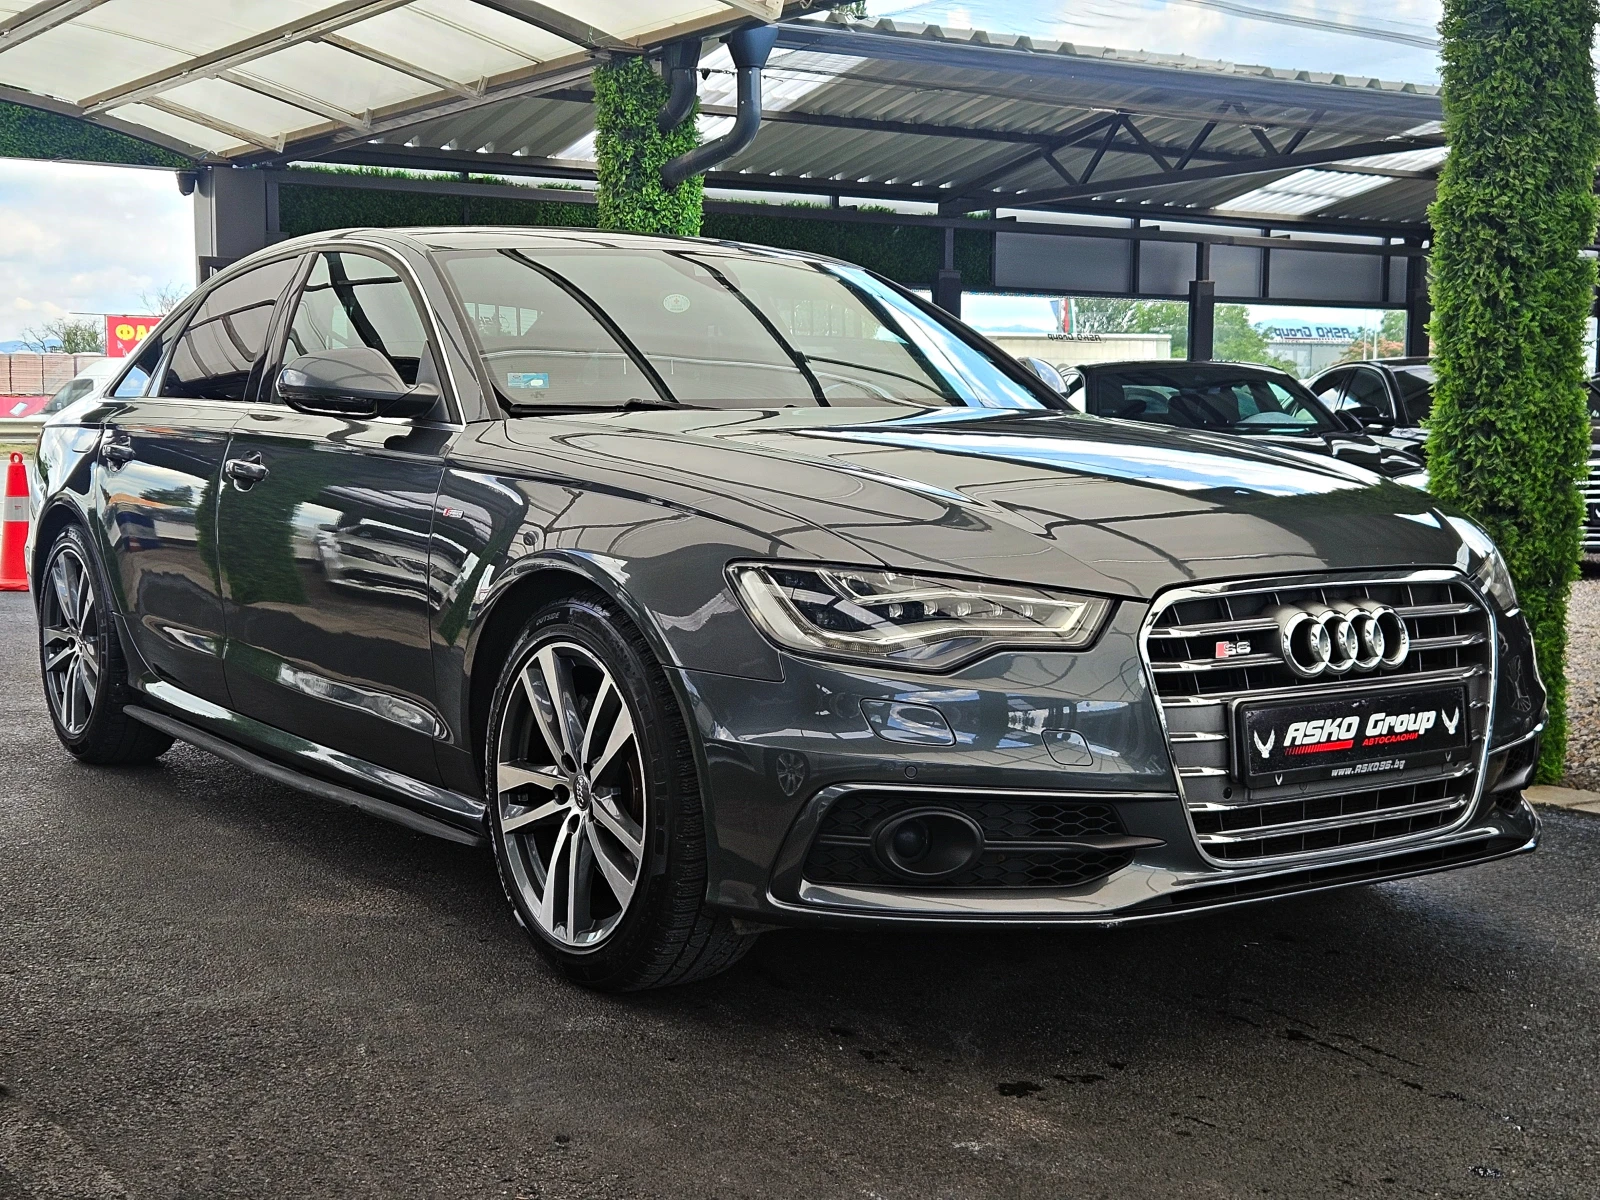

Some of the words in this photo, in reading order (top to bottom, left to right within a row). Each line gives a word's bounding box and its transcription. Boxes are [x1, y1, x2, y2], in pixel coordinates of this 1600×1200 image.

[1223, 641, 1251, 655] S6
[1283, 716, 1360, 747] ASKO
[1366, 711, 1436, 735] Group
[1362, 732, 1419, 746] АВТОСАЛОНИ
